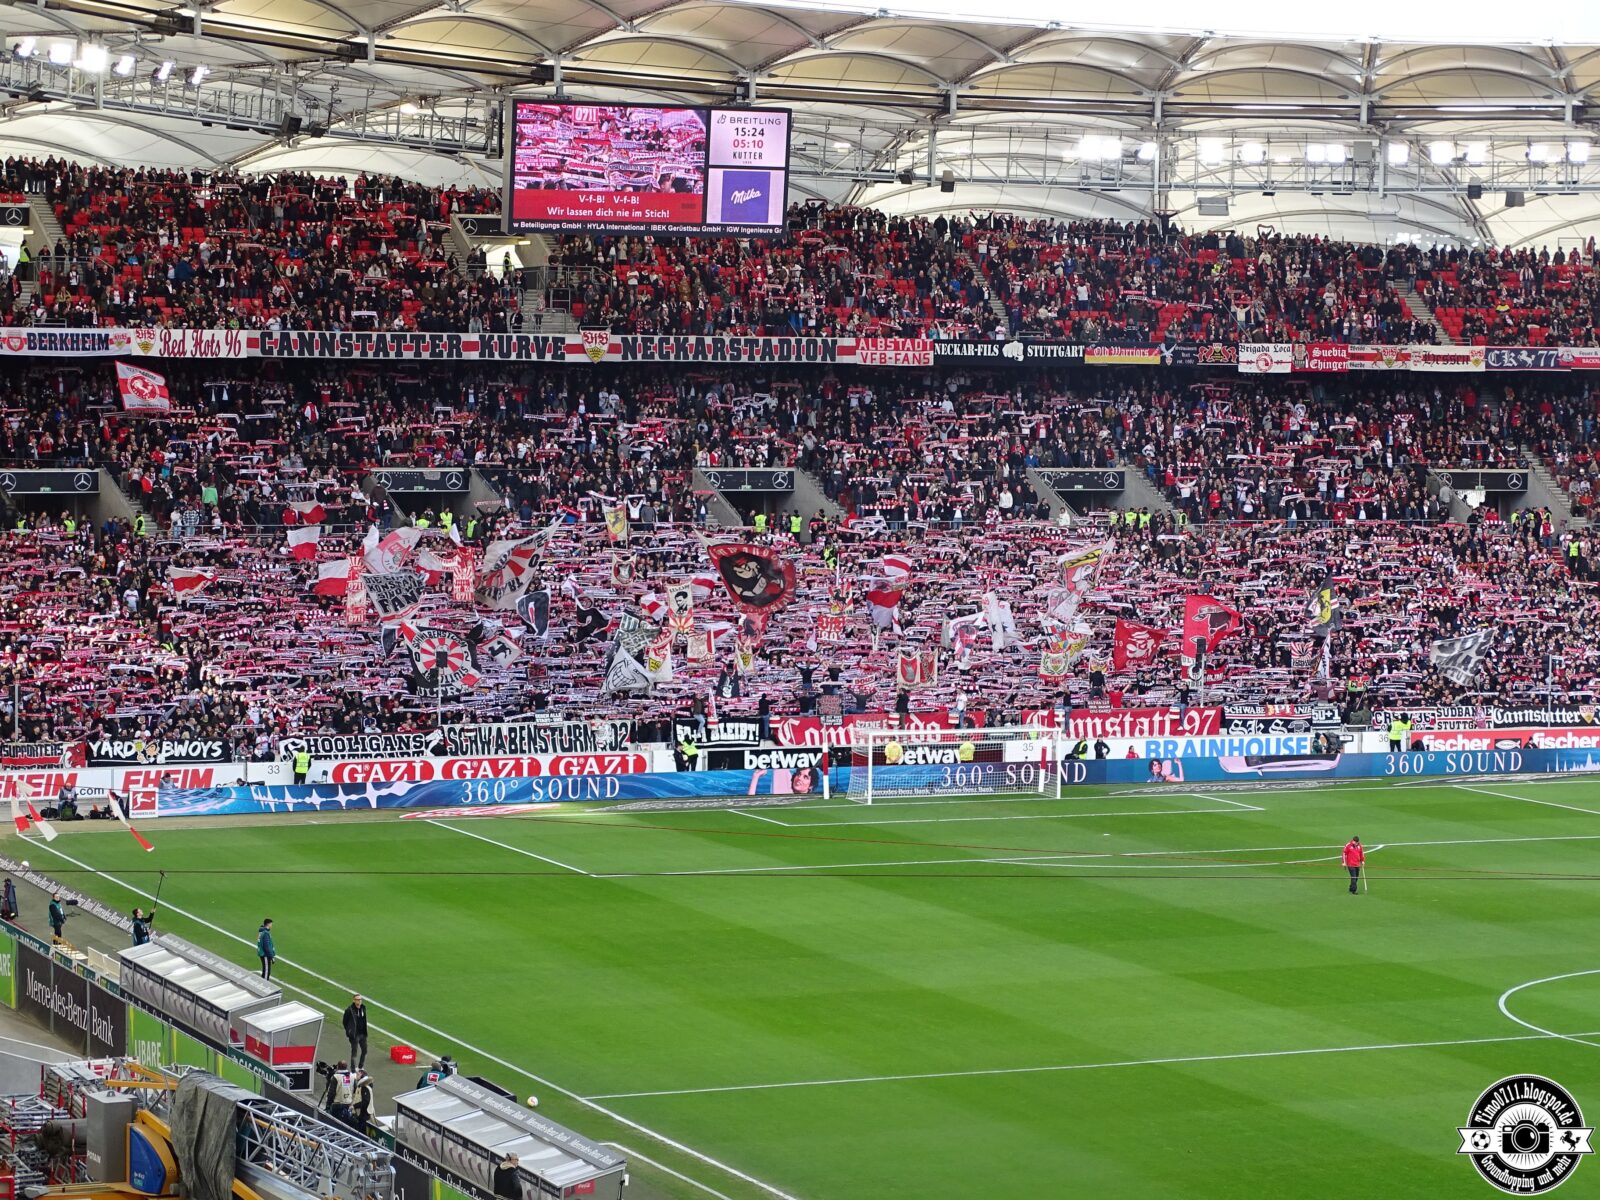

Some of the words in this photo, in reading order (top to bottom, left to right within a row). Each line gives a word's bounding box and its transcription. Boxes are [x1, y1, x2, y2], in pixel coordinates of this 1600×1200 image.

[729, 116, 782, 125] BREITLING
[734, 127, 765, 137] 15:24
[732, 139, 764, 149] 05:10
[732, 151, 763, 160] KUTTER
[578, 194, 605, 204] V-f-B!
[613, 195, 640, 205] V-f-B!
[731, 187, 762, 204] Milka
[546, 206, 565, 216] Wir
[566, 206, 593, 216] lassen
[595, 207, 613, 217] dich
[616, 208, 630, 217] nie
[632, 208, 642, 217] im
[644, 209, 670, 218] Stich!
[520, 221, 560, 230] Beteiligungs
[606, 223, 646, 231] International
[701, 225, 722, 233] GmbH
[740, 226, 773, 234] Ingenieure
[26, 332, 110, 351] BERKHEIM
[159, 329, 189, 358] Red
[190, 329, 222, 358] Hots
[225, 329, 242, 358] 96
[259, 331, 463, 360] CANNSTATTER
[478, 336, 566, 361] KURVE
[620, 336, 838, 362] NECKARSTADION
[857, 338, 933, 352] ALBSTADT
[1239, 344, 1270, 354] Brigada
[1273, 345, 1291, 353] Loca
[860, 350, 931, 366] VFB-FANS
[934, 343, 999, 357] NECKAR-FILS
[1027, 344, 1085, 359] STUTTGART
[1093, 346, 1114, 358] Old
[1116, 345, 1149, 358] Warriors
[1312, 347, 1347, 358] Suebia
[1538, 350, 1558, 367] 77
[1311, 708, 1342, 722] 50+1
[88, 740, 135, 758] YARD
[161, 740, 223, 758] BWOYS
[303, 733, 426, 754] HOOLIGANS
[1145, 736, 1308, 759] BRAINHOUSE
[1423, 733, 1491, 751] fischer
[1531, 731, 1600, 749] fischer
[1, 743, 64, 758] SUPPORTERS
[267, 764, 280, 774] 33
[1384, 752, 1435, 775] 360°
[1446, 751, 1522, 773] SOUND
[941, 764, 994, 787] 360°
[1006, 761, 1087, 785] SOUND
[0, 772, 78, 799] HEIM
[461, 779, 520, 803] 360°
[532, 776, 620, 801] SOUND
[26, 967, 88, 1032] Mercedes-Benz
[91, 1005, 114, 1048] Bank
